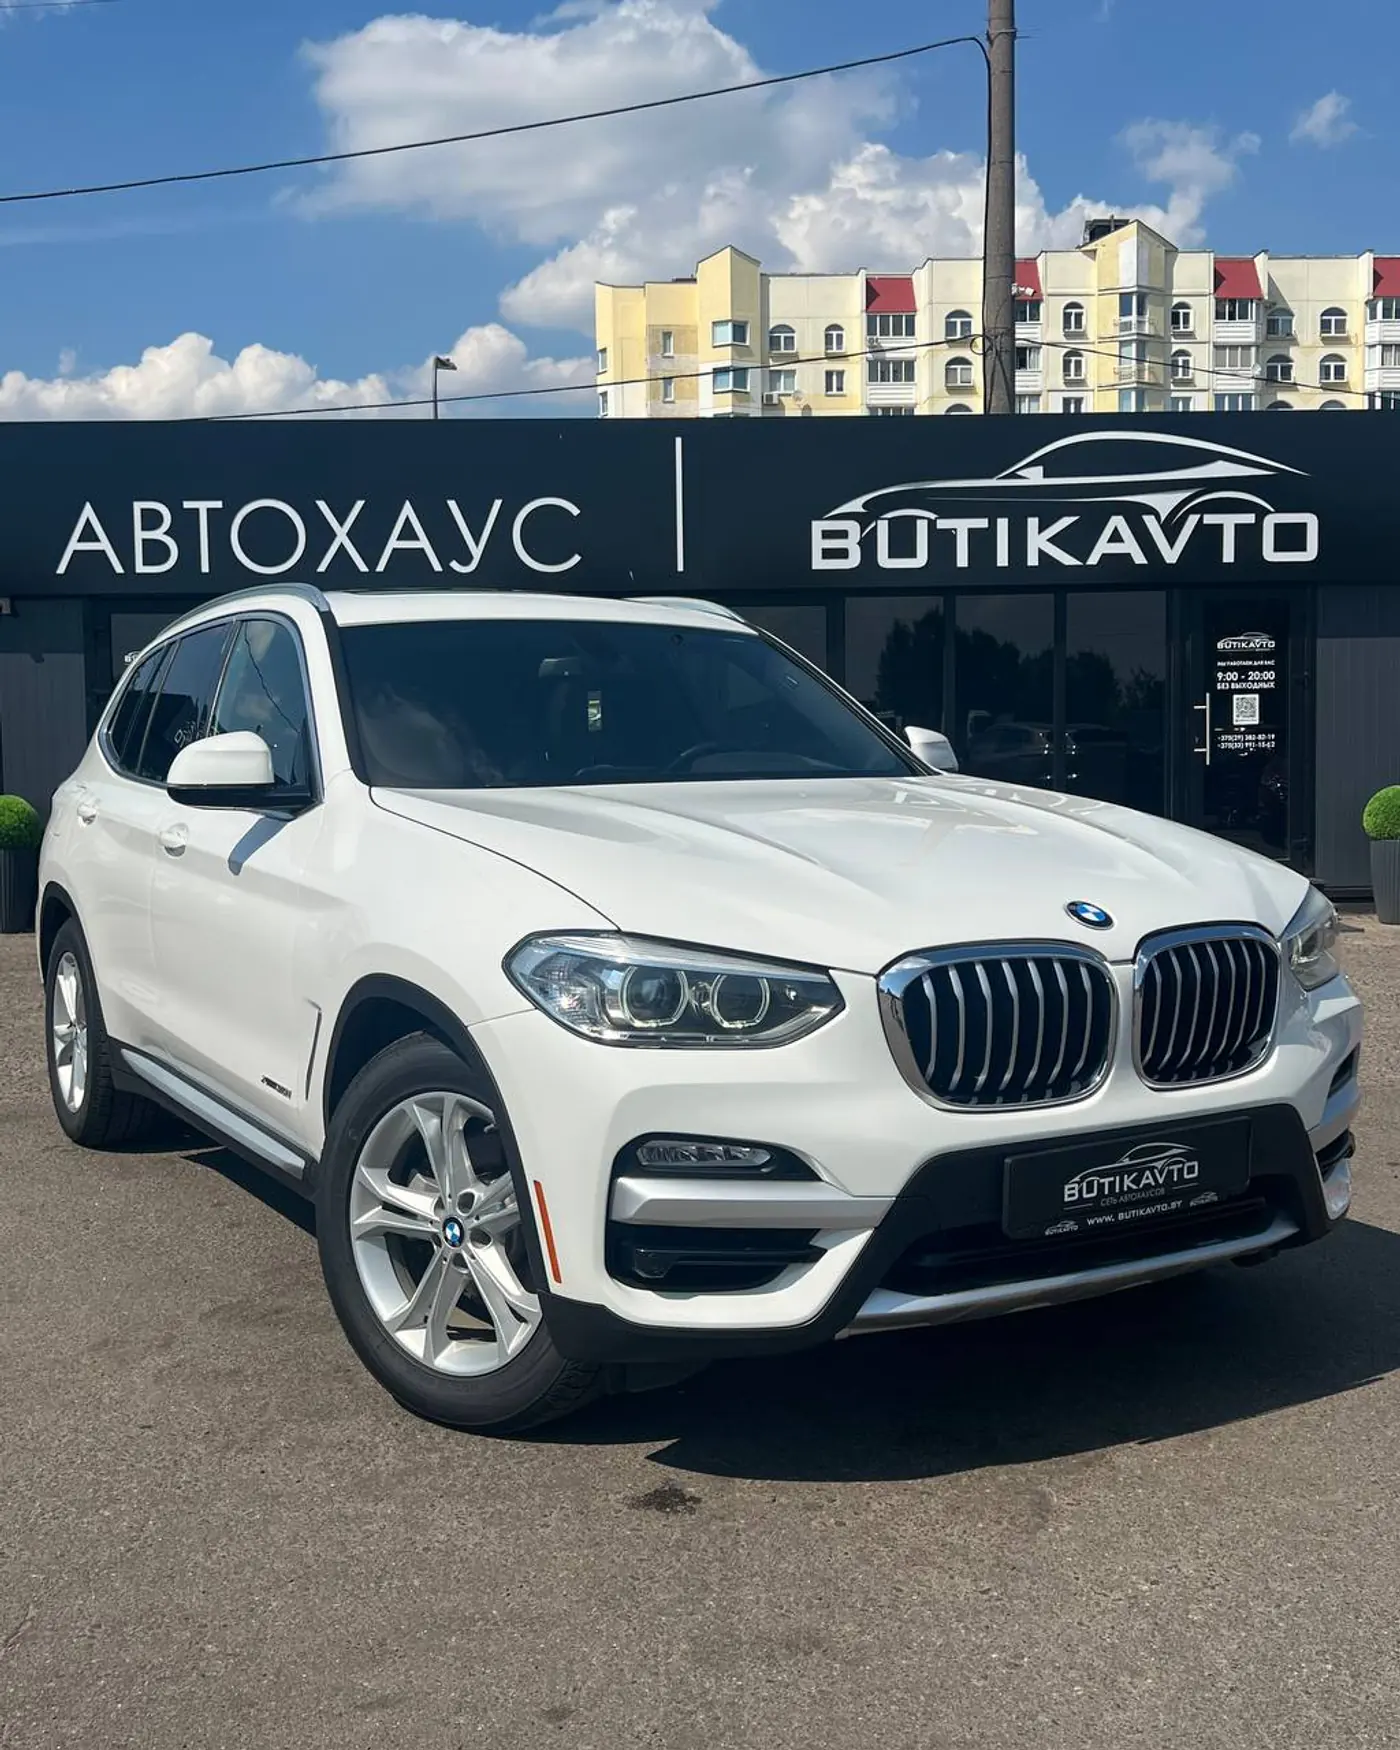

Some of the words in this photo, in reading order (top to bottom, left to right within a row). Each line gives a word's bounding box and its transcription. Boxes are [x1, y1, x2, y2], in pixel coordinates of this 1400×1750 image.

[55, 497, 582, 575] АВТОХАУС
[811, 512, 1319, 570] BUTIKAVTO
[1217, 640, 1275, 649] BUTIKAVTO
[1217, 671, 1239, 681] 9:00
[1248, 671, 1275, 680] 20:00
[1217, 682, 1229, 690] БЕЗ
[1231, 681, 1275, 690] ВЫХОДНЫХ
[1063, 1160, 1199, 1202] BUTIKAVTO
